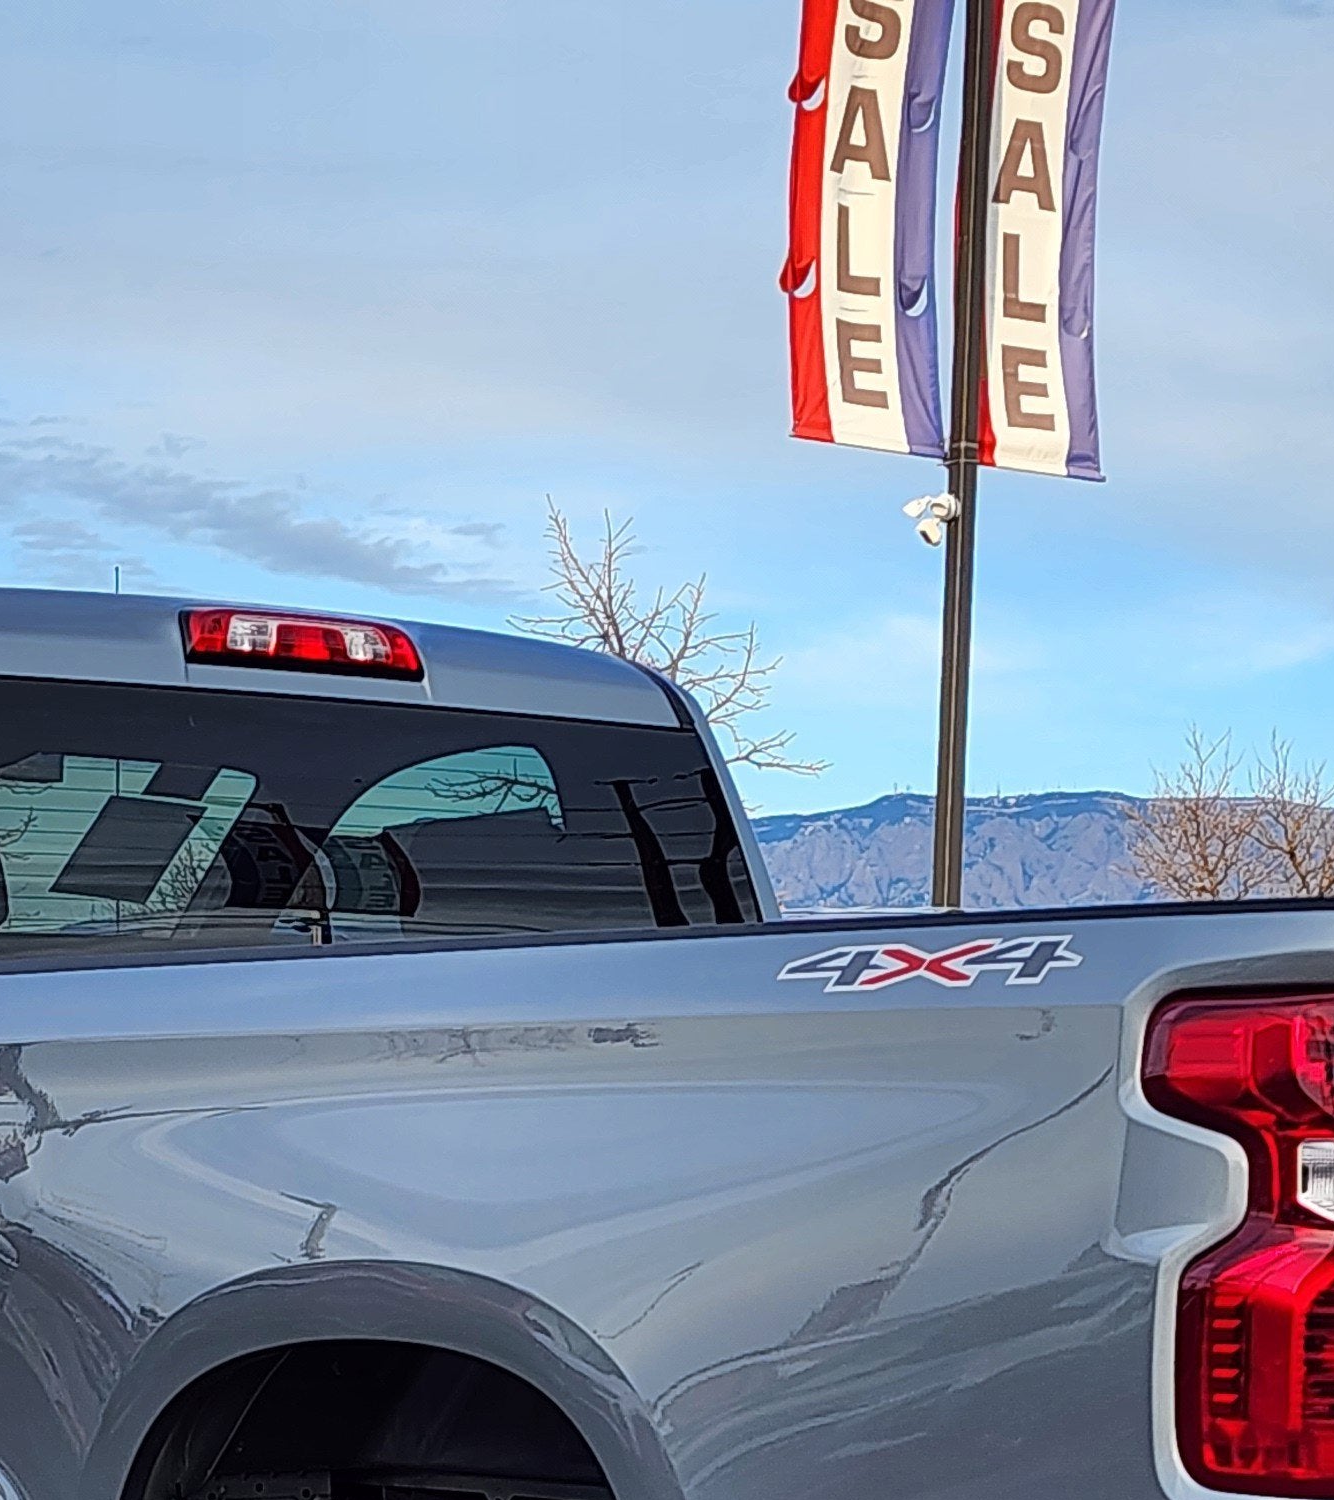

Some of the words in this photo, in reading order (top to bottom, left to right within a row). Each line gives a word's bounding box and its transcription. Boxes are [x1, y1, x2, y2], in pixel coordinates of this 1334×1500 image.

[830, 0, 903, 410] SALE
[992, 0, 1065, 432] SALE
[777, 934, 1084, 993] 4X4
